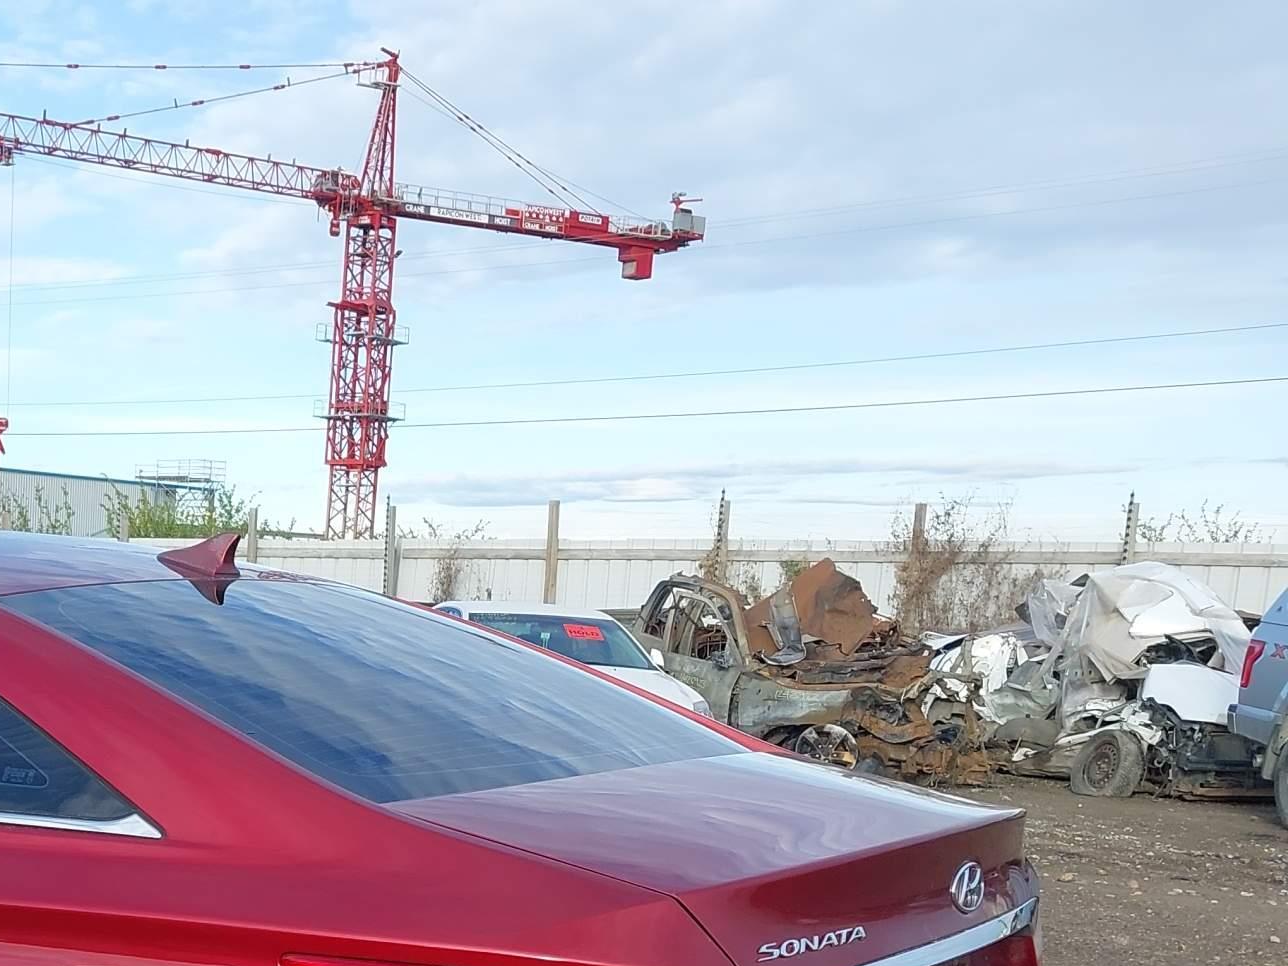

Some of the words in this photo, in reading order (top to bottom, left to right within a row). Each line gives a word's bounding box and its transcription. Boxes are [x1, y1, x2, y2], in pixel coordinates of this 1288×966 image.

[405, 205, 425, 213] CRANE
[494, 217, 511, 226] HOIST
[757, 925, 866, 962] SONATA
